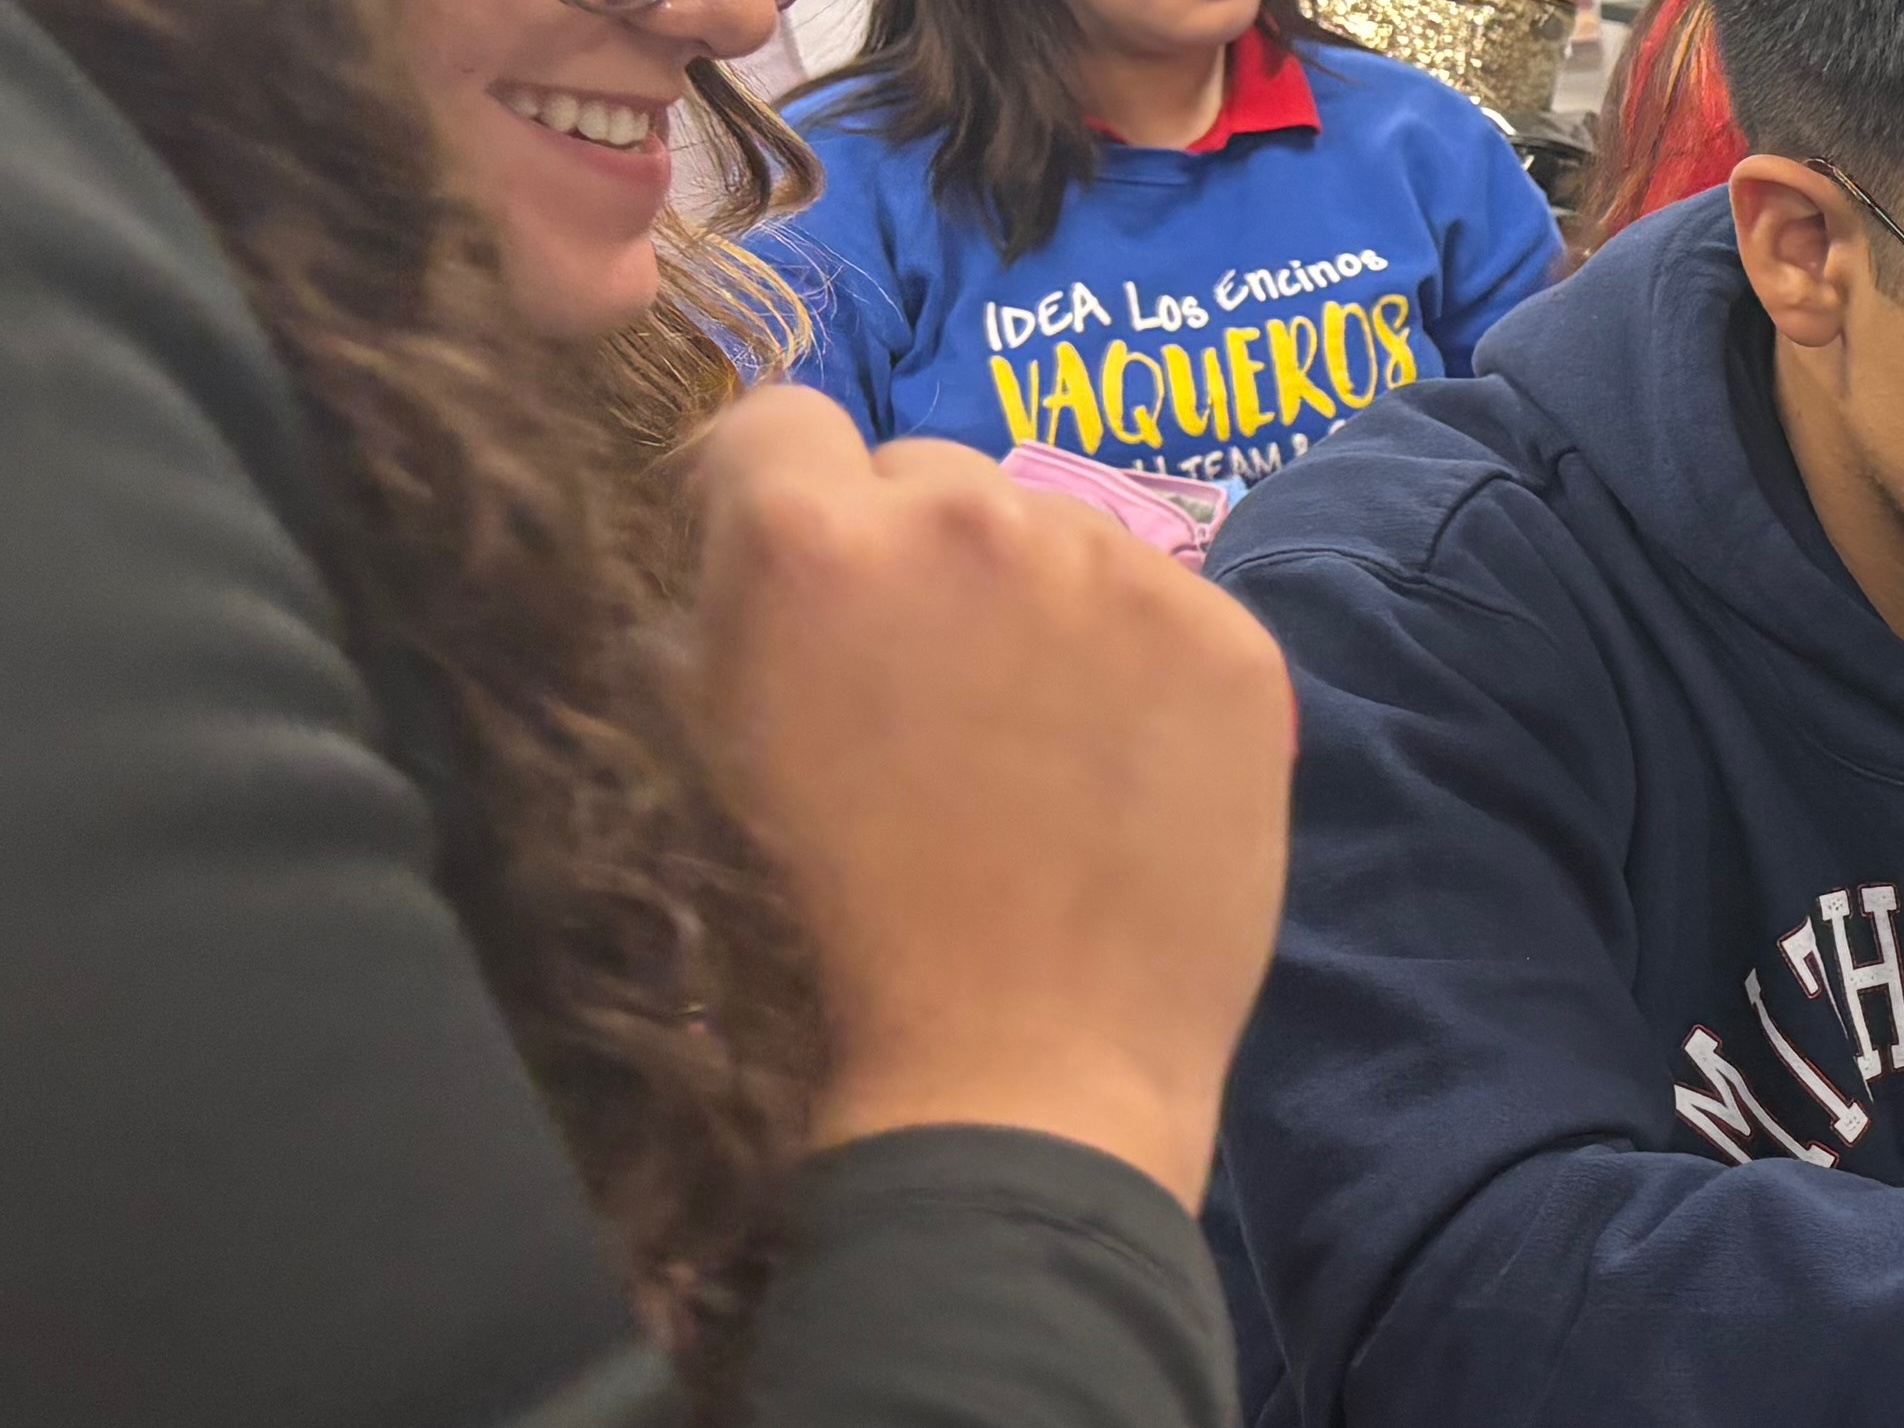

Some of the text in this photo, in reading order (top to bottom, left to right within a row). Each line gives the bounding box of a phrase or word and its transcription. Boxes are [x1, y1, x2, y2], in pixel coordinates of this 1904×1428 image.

[986, 248, 1389, 352] IDEA Los Encinos
[990, 293, 1418, 455] VAQUEROS
[1178, 441, 1284, 479] TEAM
